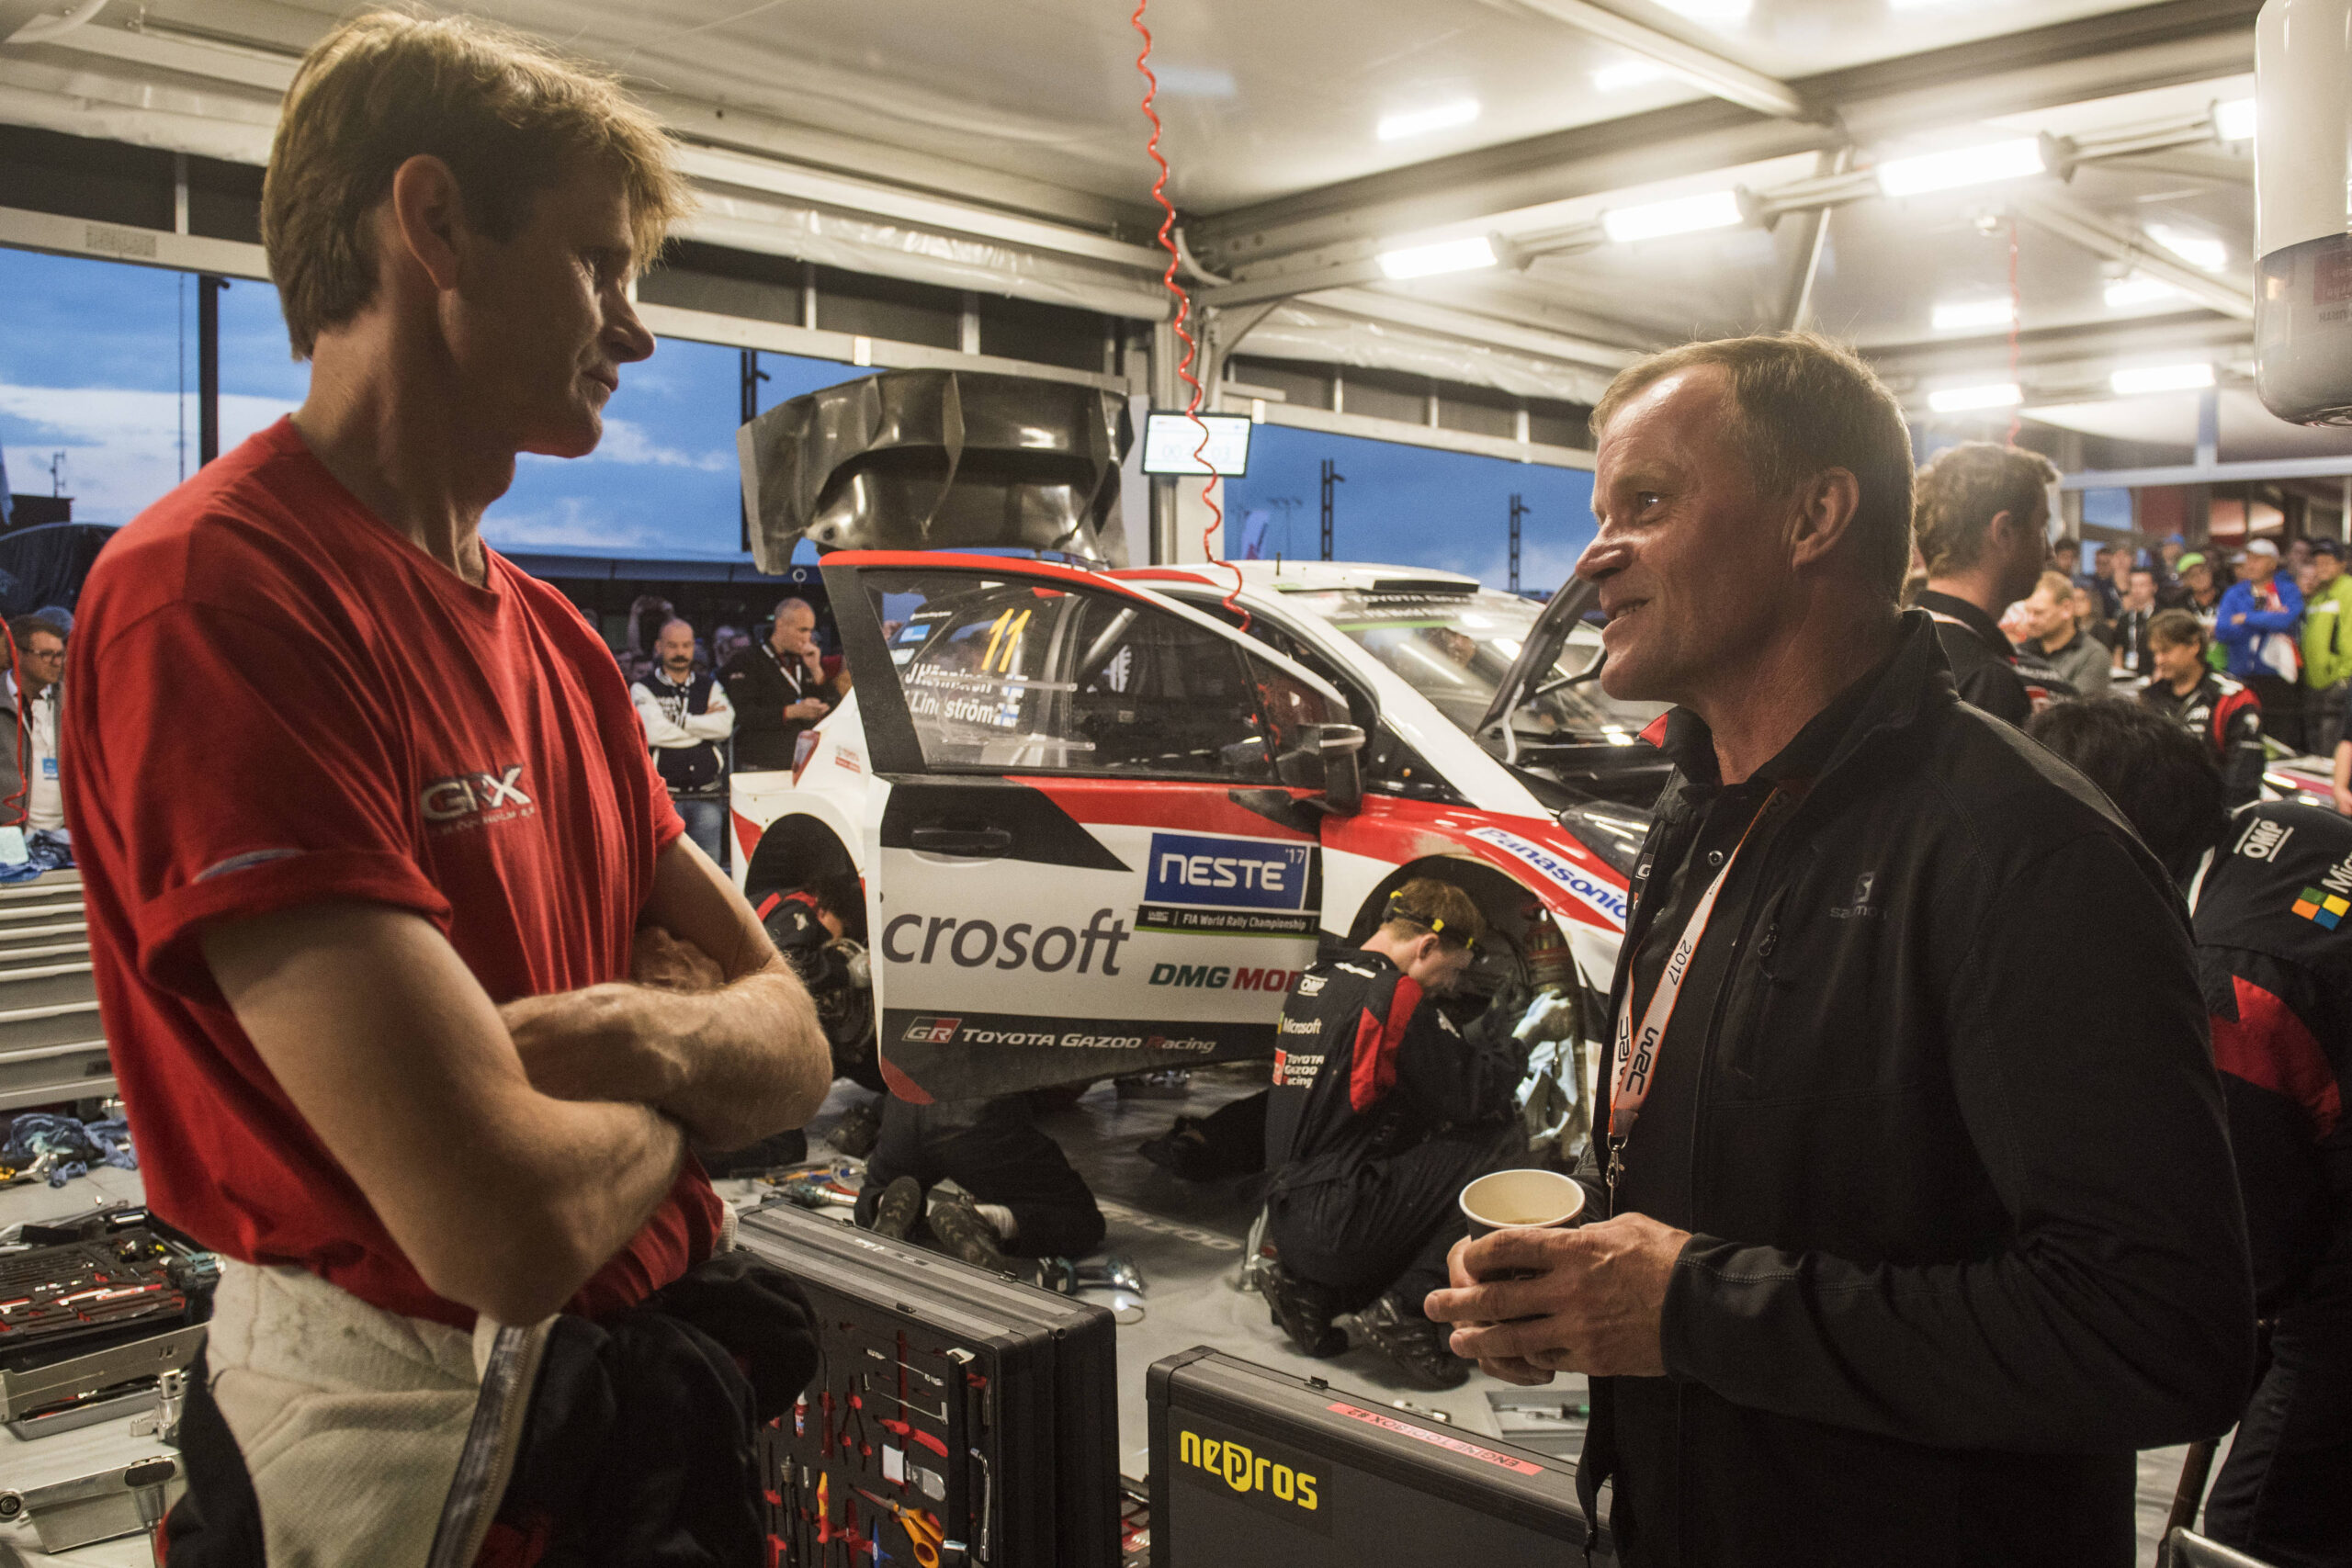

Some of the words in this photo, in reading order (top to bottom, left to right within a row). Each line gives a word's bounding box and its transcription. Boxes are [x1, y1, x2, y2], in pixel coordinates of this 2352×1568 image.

[981, 607, 1033, 673] 11
[910, 691, 995, 724] Linström
[2244, 819, 2285, 859] OMP
[1159, 852, 1287, 892] NESTE
[1477, 828, 1626, 919] Panasonic
[1182, 912, 1199, 925] FIA
[1200, 914, 1226, 927] World
[1227, 915, 1247, 929] Rally
[1249, 916, 1306, 931] Championship
[879, 905, 1131, 976] crosoft
[1148, 963, 1231, 988] DMG
[1668, 939, 1692, 986] 2017
[907, 1026, 954, 1043] GR
[963, 1028, 1057, 1047] TOYOTA
[1060, 1032, 1143, 1050] GAZOO
[1145, 1035, 1217, 1054] Racing
[1283, 1017, 1323, 1035] Microsoft
[1286, 1054, 1325, 1066] TOYOTA
[1618, 1016, 1630, 1077] RC
[1625, 1026, 1659, 1096] WRC
[1347, 1408, 1367, 1418] #2
[1370, 1416, 1453, 1446] TOOLBOX
[1454, 1440, 1521, 1468] ENGINE
